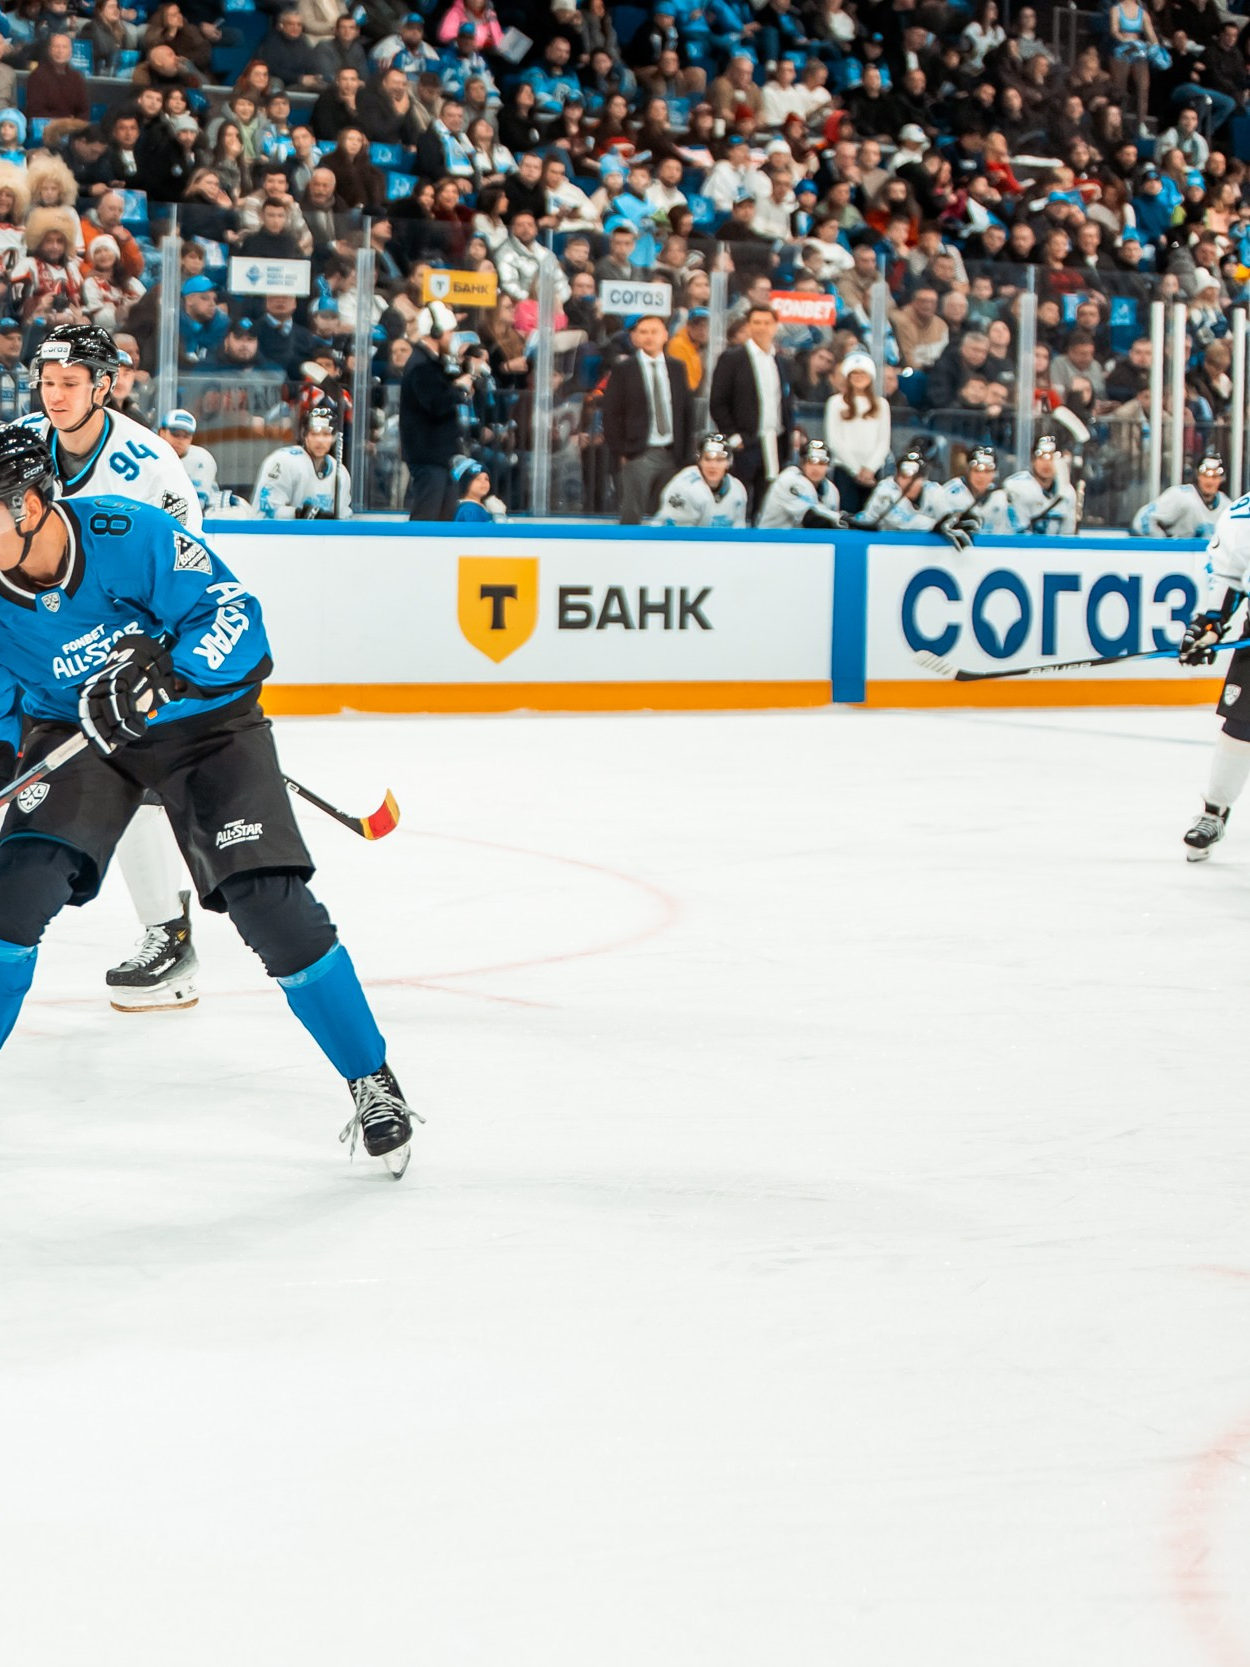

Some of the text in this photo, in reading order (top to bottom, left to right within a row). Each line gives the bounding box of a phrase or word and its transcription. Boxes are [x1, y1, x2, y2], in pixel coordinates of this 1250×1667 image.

[453, 281, 489, 295] БАНК
[610, 289, 665, 306] согаз
[23, 463, 44, 479] CCM
[109, 439, 159, 482] 94
[479, 583, 715, 630] Т БАНК
[901, 567, 1199, 660] согаз
[62, 623, 106, 655] FONBET
